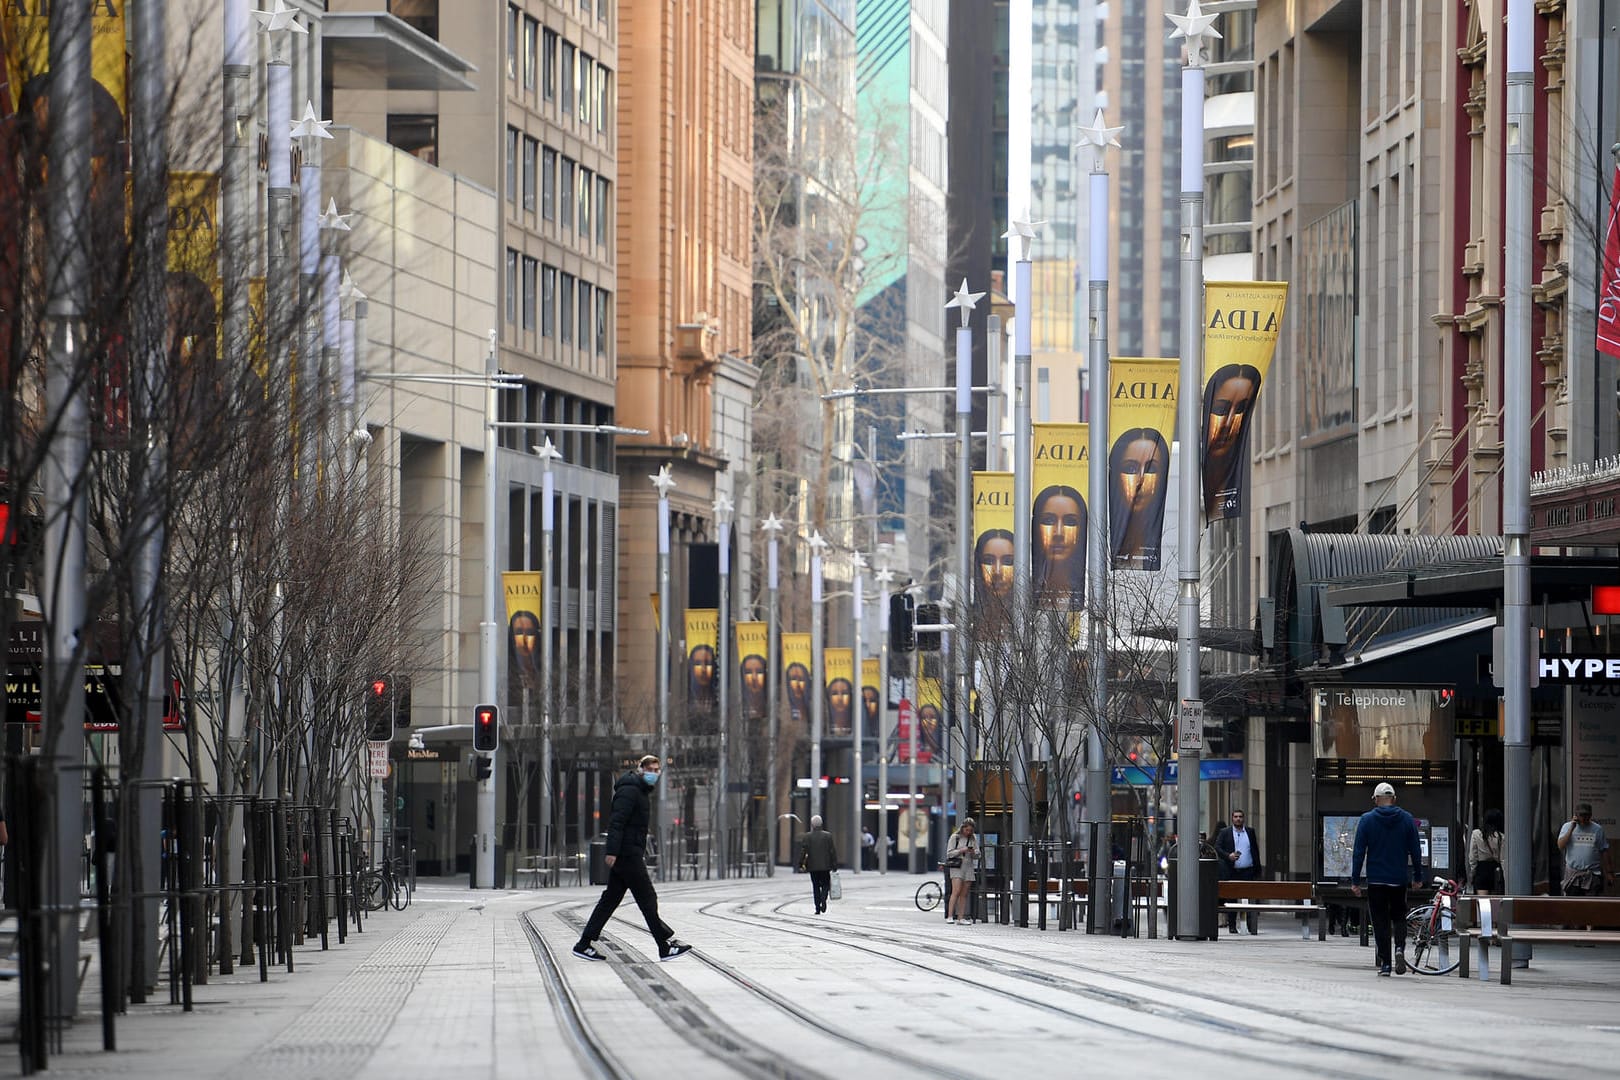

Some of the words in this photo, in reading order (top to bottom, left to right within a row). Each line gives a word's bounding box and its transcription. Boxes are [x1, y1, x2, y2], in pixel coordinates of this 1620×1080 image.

[506, 584, 539, 595] AIDA
[687, 621, 717, 632] AIDA
[739, 632, 767, 642] AIDA
[1540, 658, 1620, 678] HYPE
[5, 682, 105, 693] WILMS
[1336, 692, 1406, 708] Telephone
[372, 750, 385, 758] ERE
